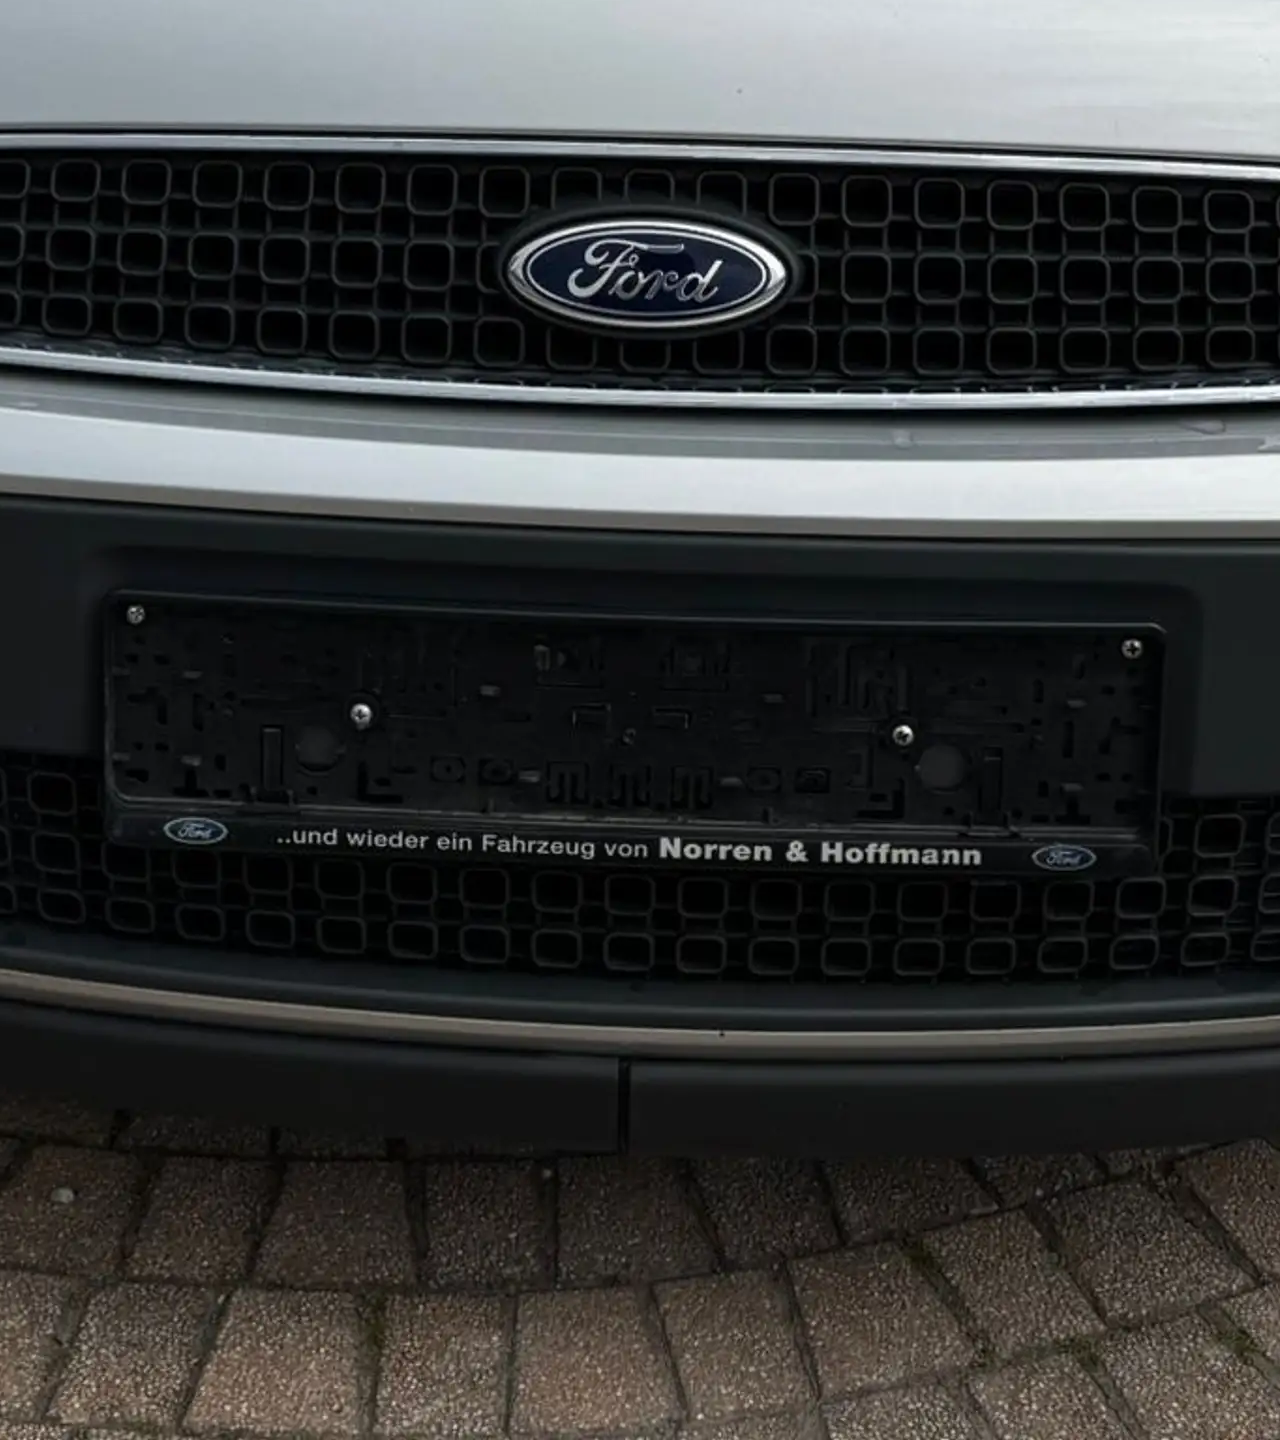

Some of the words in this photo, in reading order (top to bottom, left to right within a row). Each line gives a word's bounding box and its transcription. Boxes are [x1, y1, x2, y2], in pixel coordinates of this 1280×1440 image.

[567, 238, 724, 303] Ford
[346, 830, 429, 849] wieder
[437, 834, 472, 851] ein
[482, 834, 595, 860] Fahrzeug
[604, 843, 648, 858] von
[659, 836, 772, 862] Norren
[785, 839, 808, 863] &
[821, 841, 981, 865] Hoffmann
